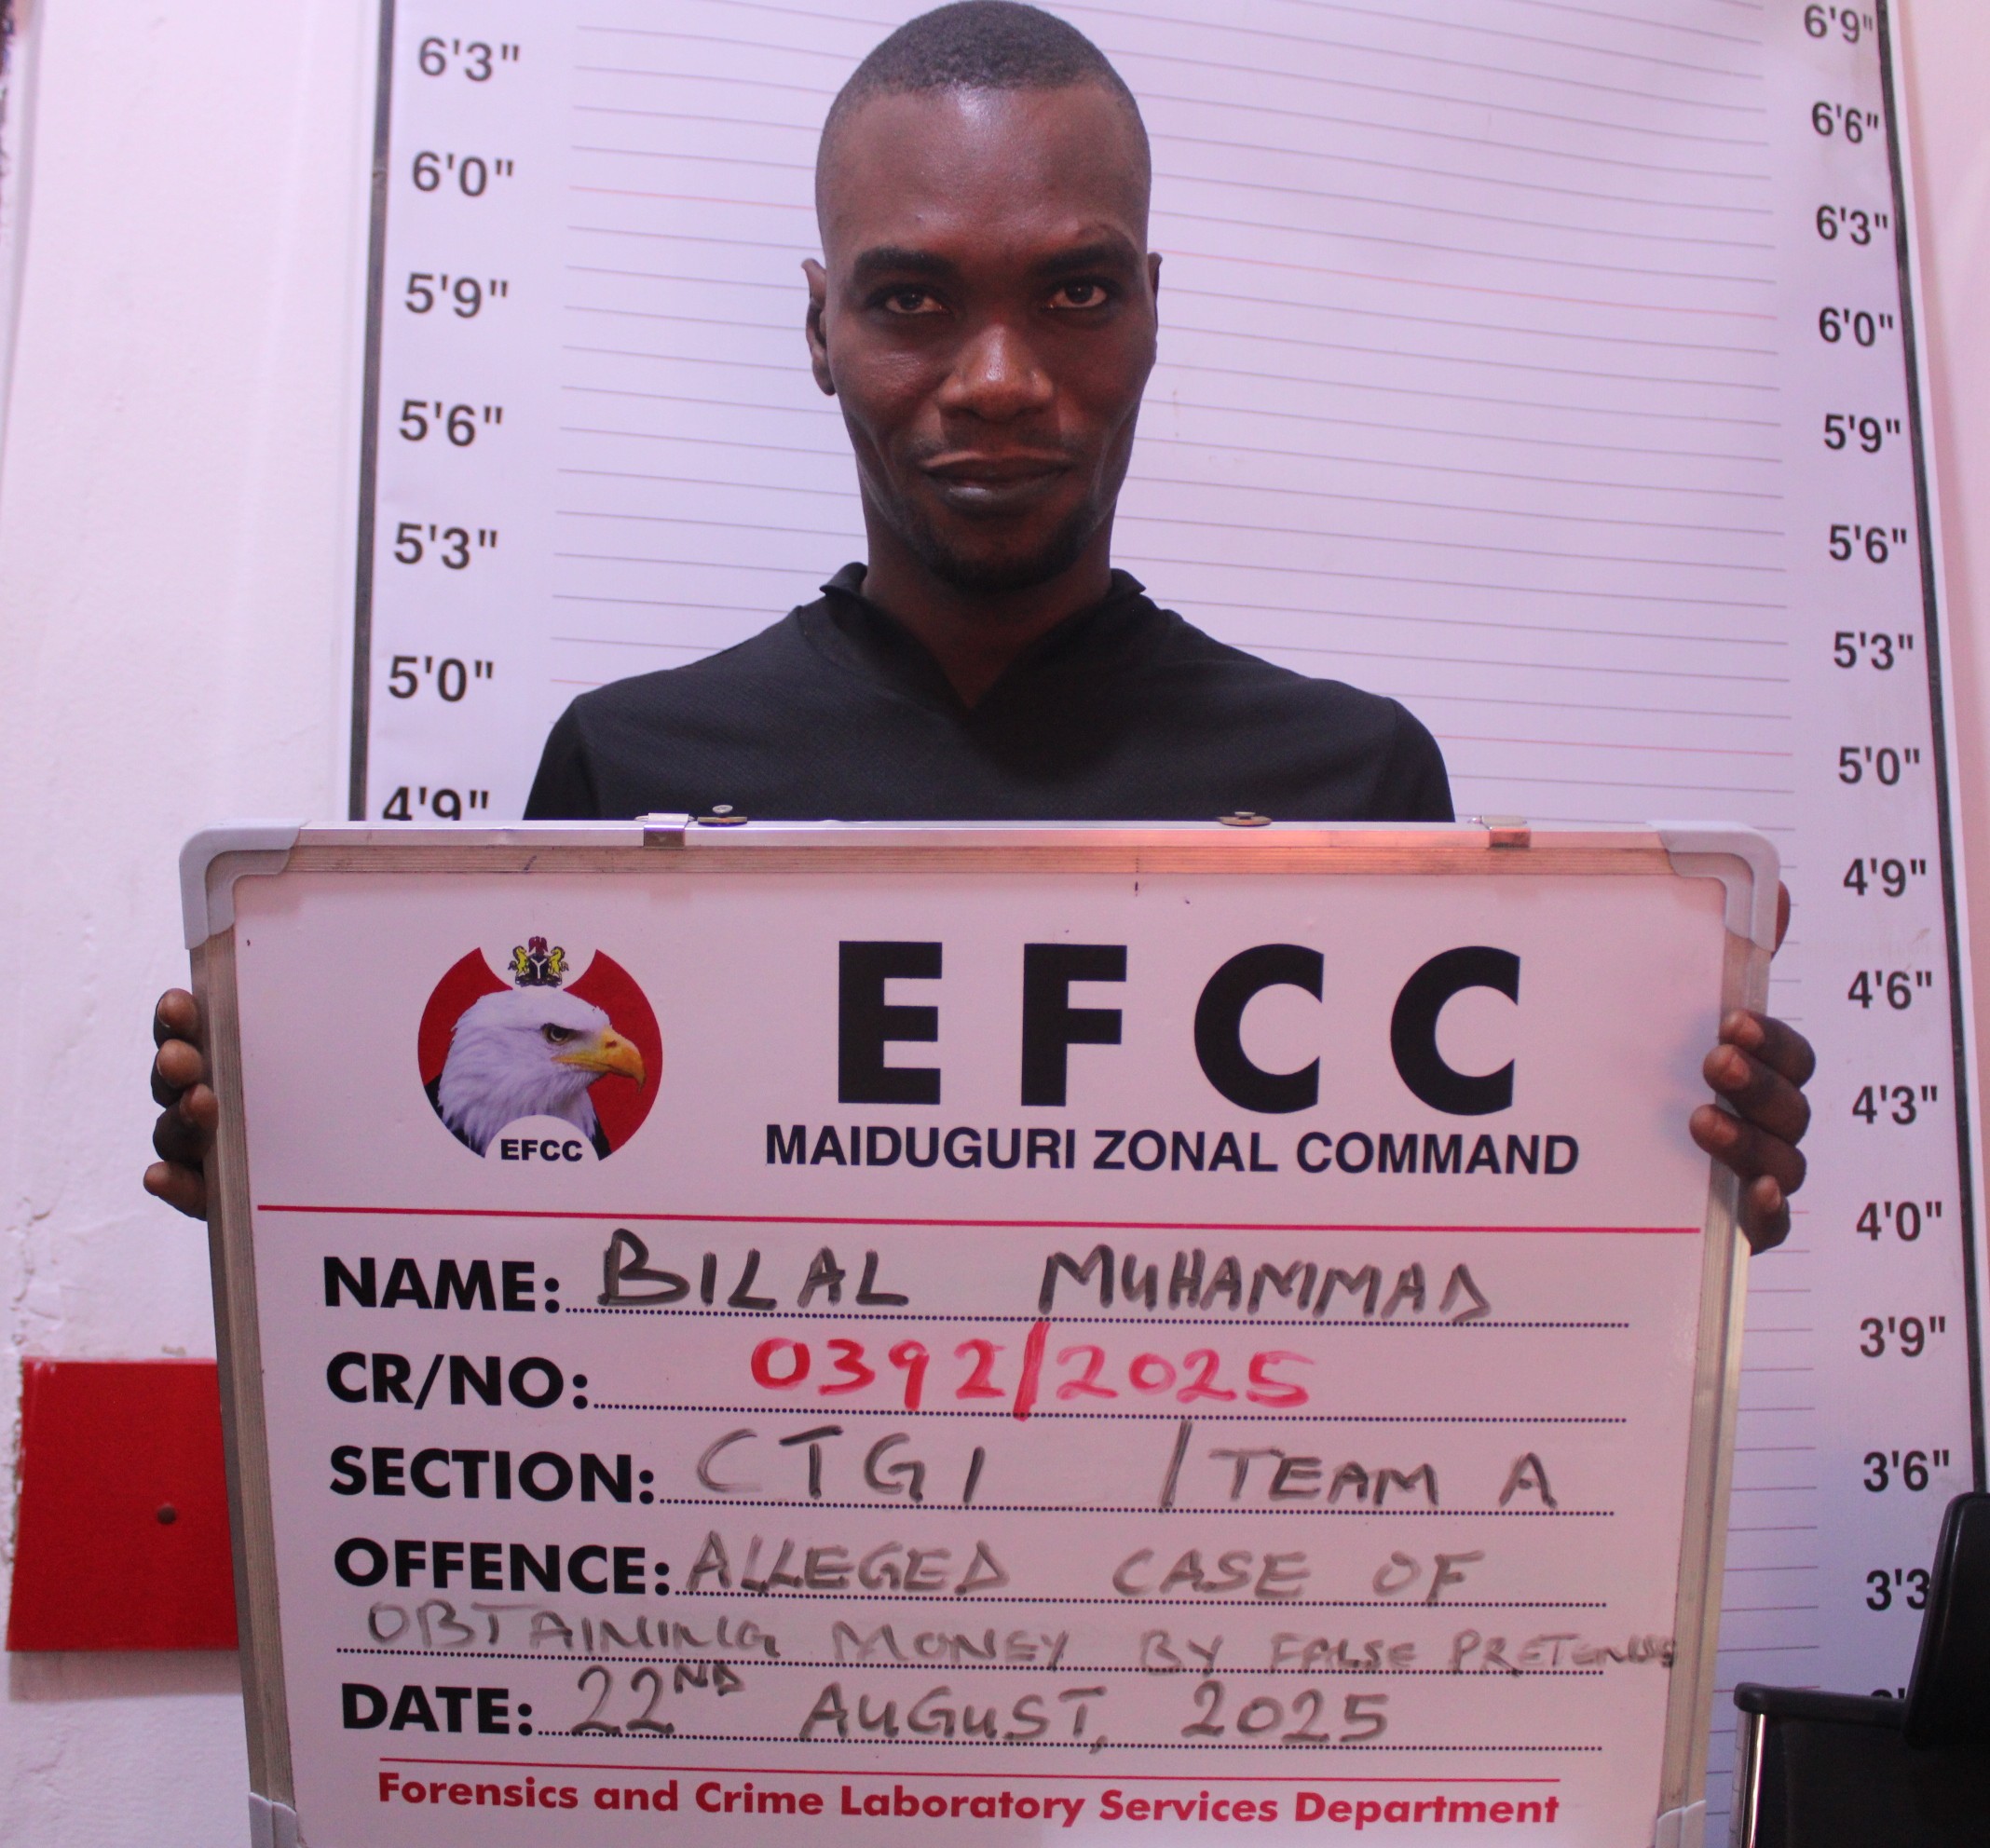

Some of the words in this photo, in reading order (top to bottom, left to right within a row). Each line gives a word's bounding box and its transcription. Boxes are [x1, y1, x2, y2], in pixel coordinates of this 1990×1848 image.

[1803, 4, 1874, 46] 6'9"
[417, 36, 521, 83] 6'3"
[1811, 101, 1879, 145] 6'6"
[411, 150, 514, 198] 6'0"
[1815, 204, 1888, 247] 6'3"
[404, 272, 509, 319] 5'9"
[1818, 306, 1894, 348] 6'0"
[399, 399, 503, 448] 5'6"
[1823, 413, 1901, 455] 5'9"
[393, 522, 498, 571] 5'3"
[1829, 523, 1907, 564] 5'6"
[1833, 631, 1914, 672] 5'3"
[388, 655, 494, 703] 5'0"
[1838, 745, 1920, 786] 5'0"
[382, 786, 489, 822] 4'9"
[1842, 857, 1927, 898] 4'9"
[1847, 970, 1932, 1011] 4'6"
[838, 940, 1520, 1117] EFCC
[1851, 1084, 1938, 1126] 4'3"
[500, 1138, 583, 1162] EFCC
[766, 1123, 1076, 1170] MAIDUGURI
[1093, 1129, 1279, 1173] ZONAL
[1296, 1131, 1579, 1175] COMMAND
[1855, 1200, 1942, 1243] 4'0"
[323, 1256, 560, 1314] NAME:
[597, 1229, 909, 1308] BILAL
[1039, 1244, 1491, 1324] MUHAMMAD
[1860, 1315, 1946, 1359] 3'9"
[326, 1351, 589, 1410] CR/NO:
[751, 1320, 1315, 1421] 0392/2025
[329, 1444, 655, 1505] SECTION:
[1498, 1452, 1558, 1508] A
[1862, 1448, 1950, 1493] 3'6"
[334, 1536, 670, 1597] OFFENCE:
[687, 1530, 1010, 1595] ALLEGED
[1111, 1547, 1311, 1599] CASE
[1372, 1550, 1485, 1605] OF
[1865, 1568, 1930, 1616] 3'3
[367, 1599, 781, 1658] OBTAINING
[831, 1621, 1070, 1670] MONEY
[1139, 1628, 1222, 1675] BY
[1270, 1632, 1416, 1672] FALSE
[341, 1682, 534, 1736] DATE:
[1180, 1680, 1389, 1744] 2025
[378, 1772, 579, 1810] Forensics
[593, 1779, 678, 1813] and
[695, 1781, 825, 1816] Crime
[840, 1784, 1086, 1828] Laboratory
[1098, 1788, 1278, 1823] Services
[1294, 1791, 1561, 1831] Department
